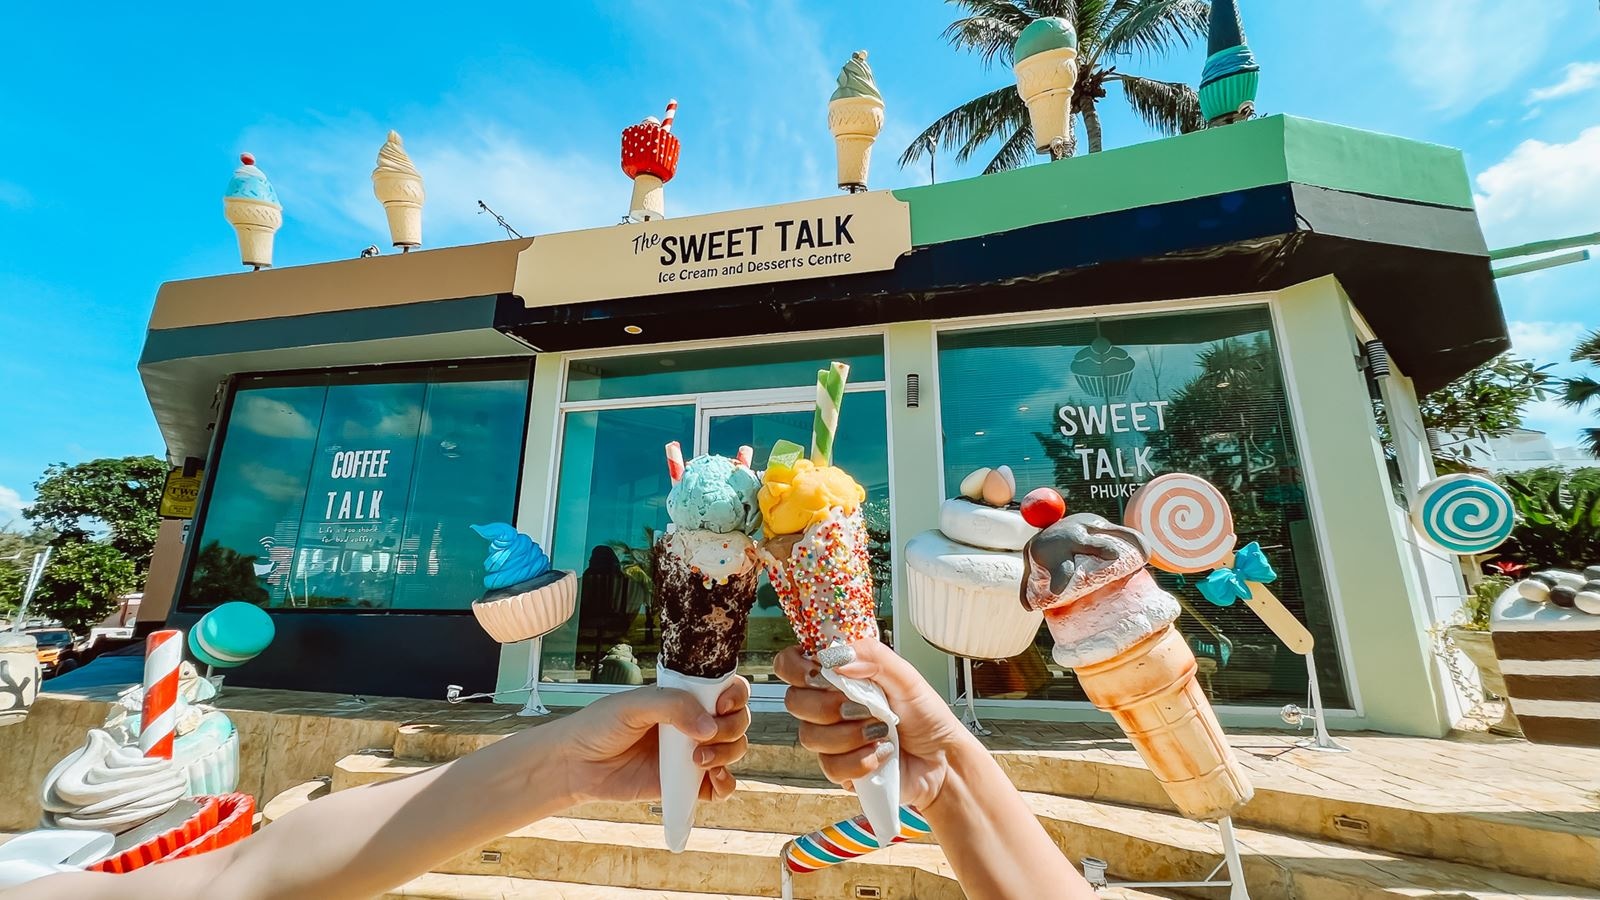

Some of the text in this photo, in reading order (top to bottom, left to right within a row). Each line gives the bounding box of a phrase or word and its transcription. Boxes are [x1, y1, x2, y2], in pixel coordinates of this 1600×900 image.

[632, 214, 855, 266] The SWEET TALK
[658, 252, 852, 283] Ice Cream and Desserts Centre
[1058, 401, 1169, 436] SWEET
[331, 450, 391, 479] COFFEE
[1074, 446, 1155, 480] TALK
[170, 487, 198, 497] TWG
[325, 490, 383, 520] TALK
